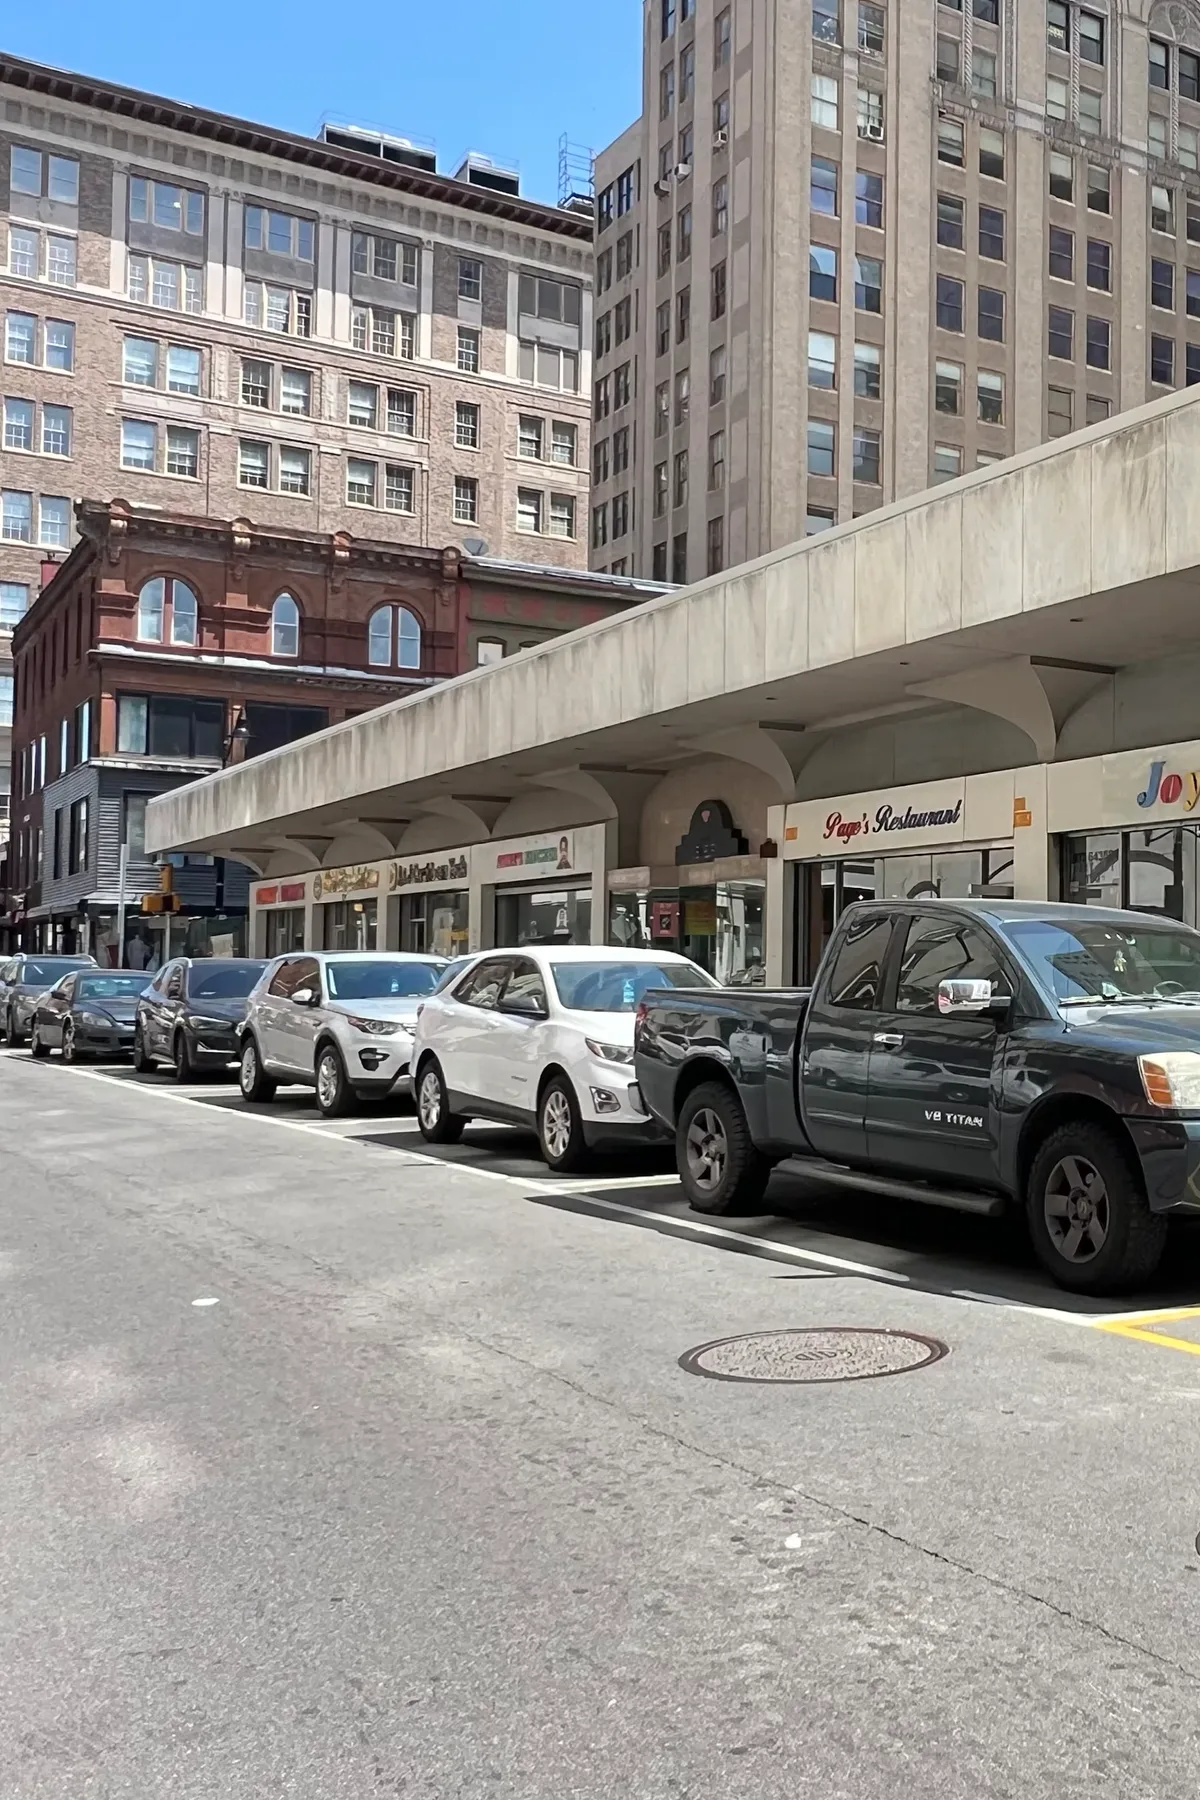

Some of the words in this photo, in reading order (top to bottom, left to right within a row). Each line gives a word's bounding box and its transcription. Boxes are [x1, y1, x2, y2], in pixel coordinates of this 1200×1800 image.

[823, 811, 870, 844] Page's
[872, 799, 963, 834] Restaurant
[924, 1110, 942, 1121] V8
[945, 1112, 983, 1127] TITAN
